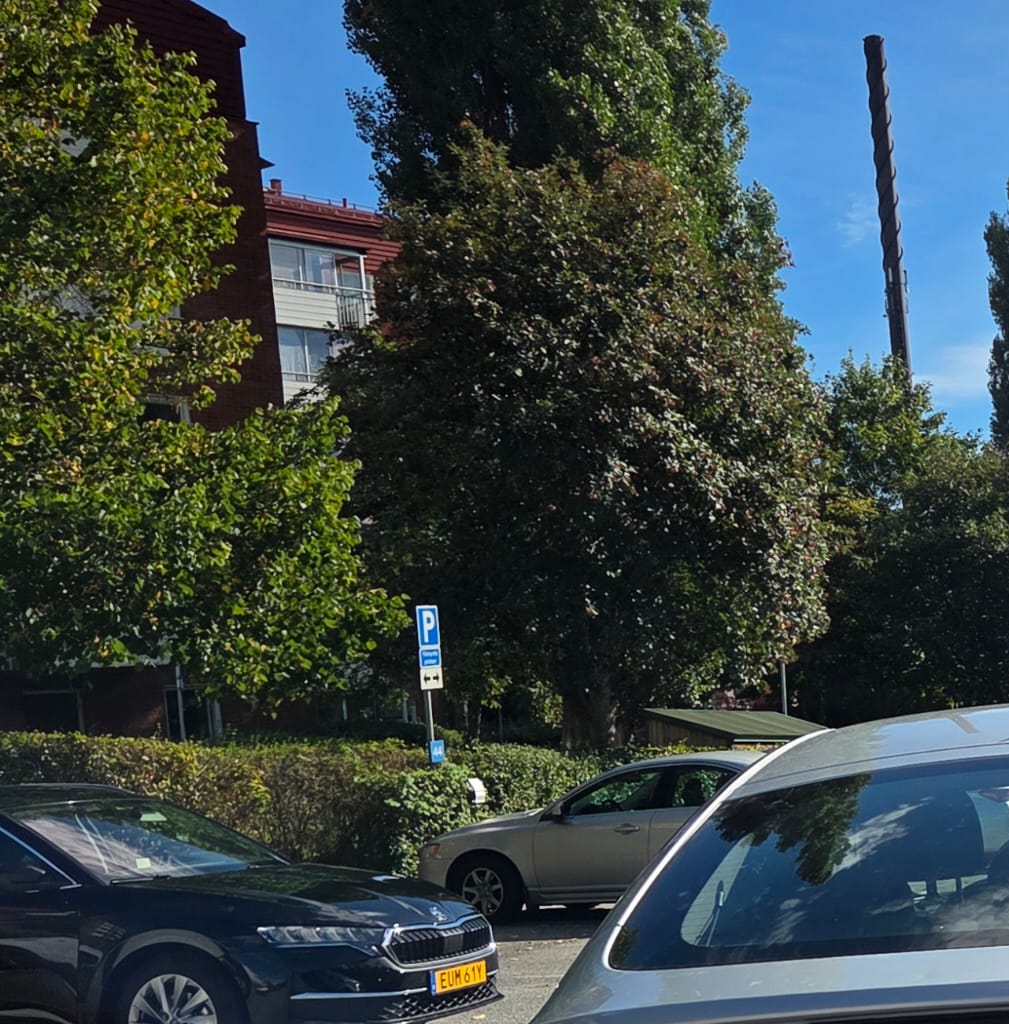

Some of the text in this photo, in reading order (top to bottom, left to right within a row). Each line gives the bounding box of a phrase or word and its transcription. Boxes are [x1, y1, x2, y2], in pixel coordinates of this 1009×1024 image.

[422, 610, 436, 643] P
[440, 964, 482, 989] EUM 61Y
